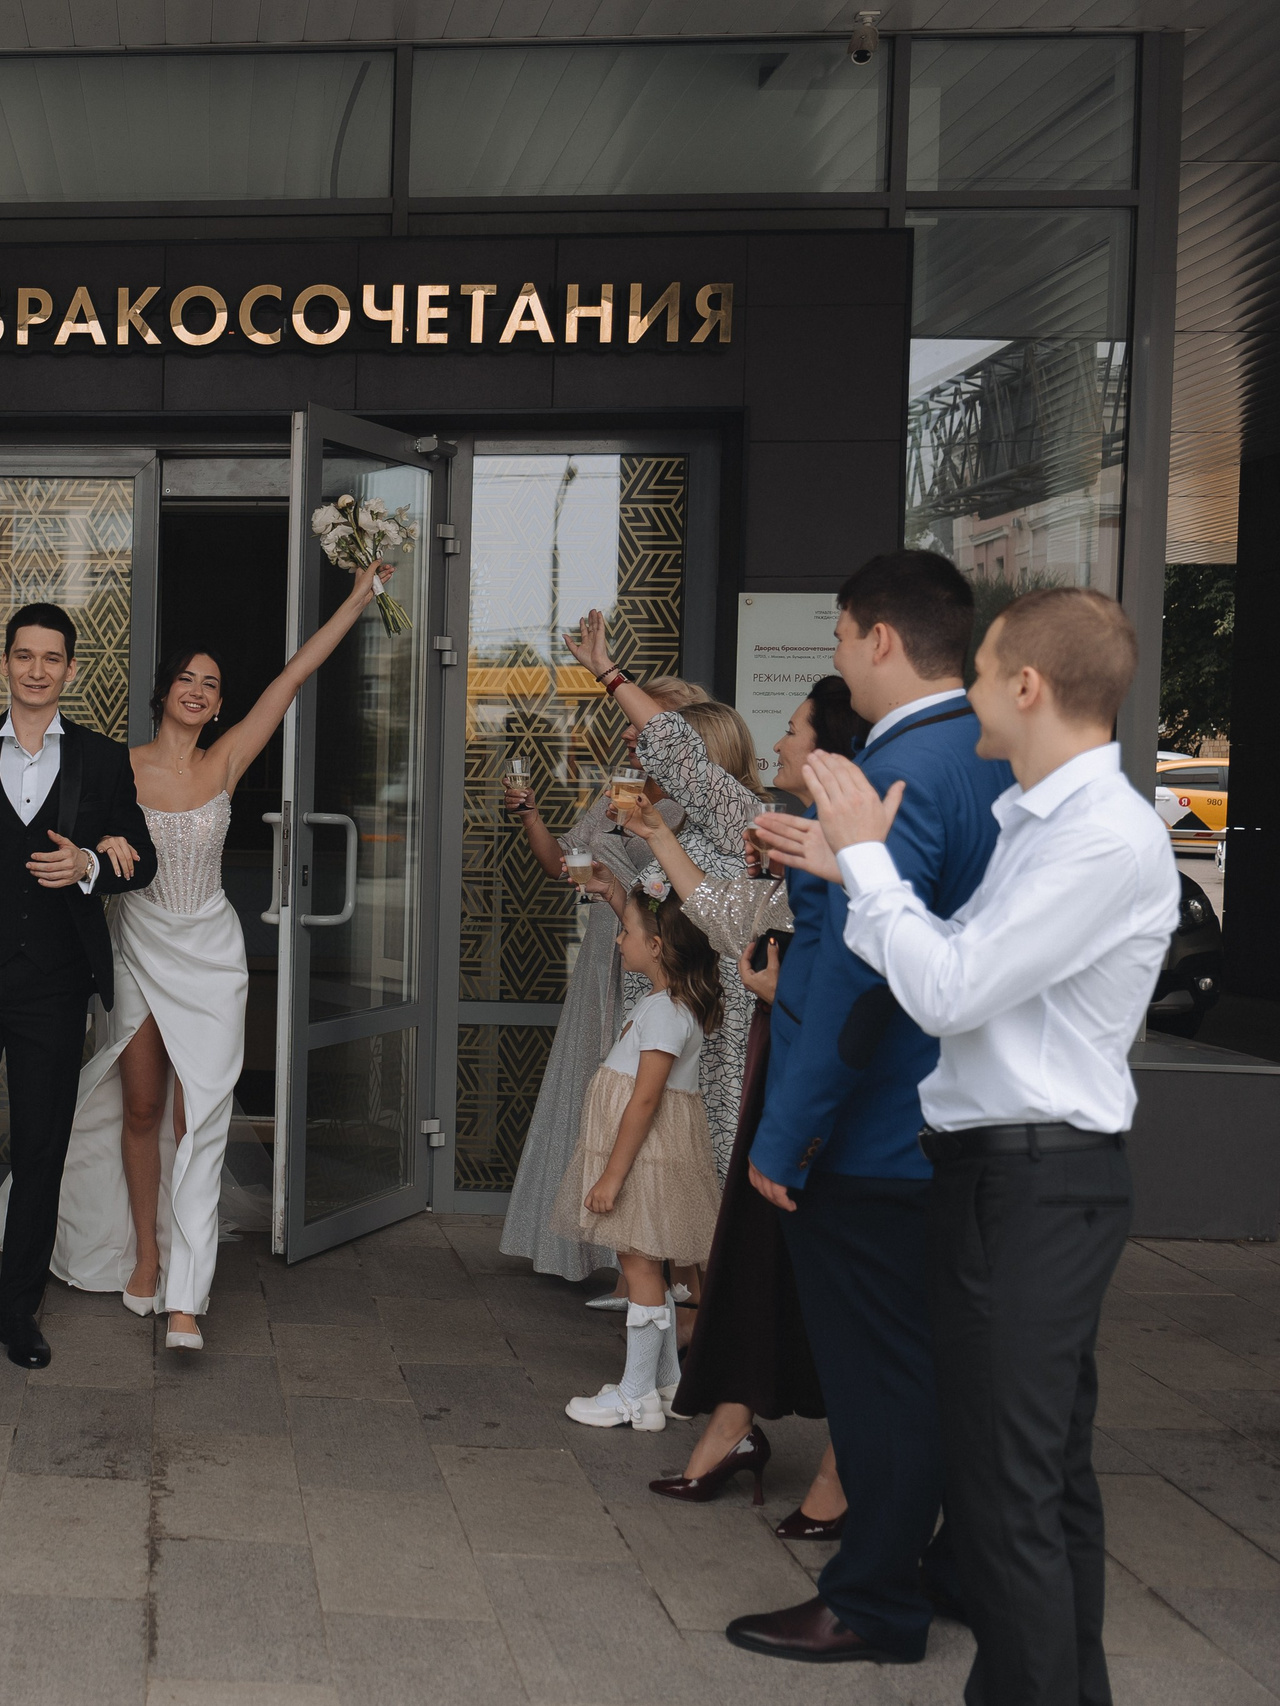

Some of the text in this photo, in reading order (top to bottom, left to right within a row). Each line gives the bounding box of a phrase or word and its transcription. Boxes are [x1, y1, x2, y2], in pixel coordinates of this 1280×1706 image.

[754, 644, 836, 652] Дворец бракосочетания
[753, 673, 791, 682] РЕЖИМ
[1181, 798, 1223, 806] Я 980
